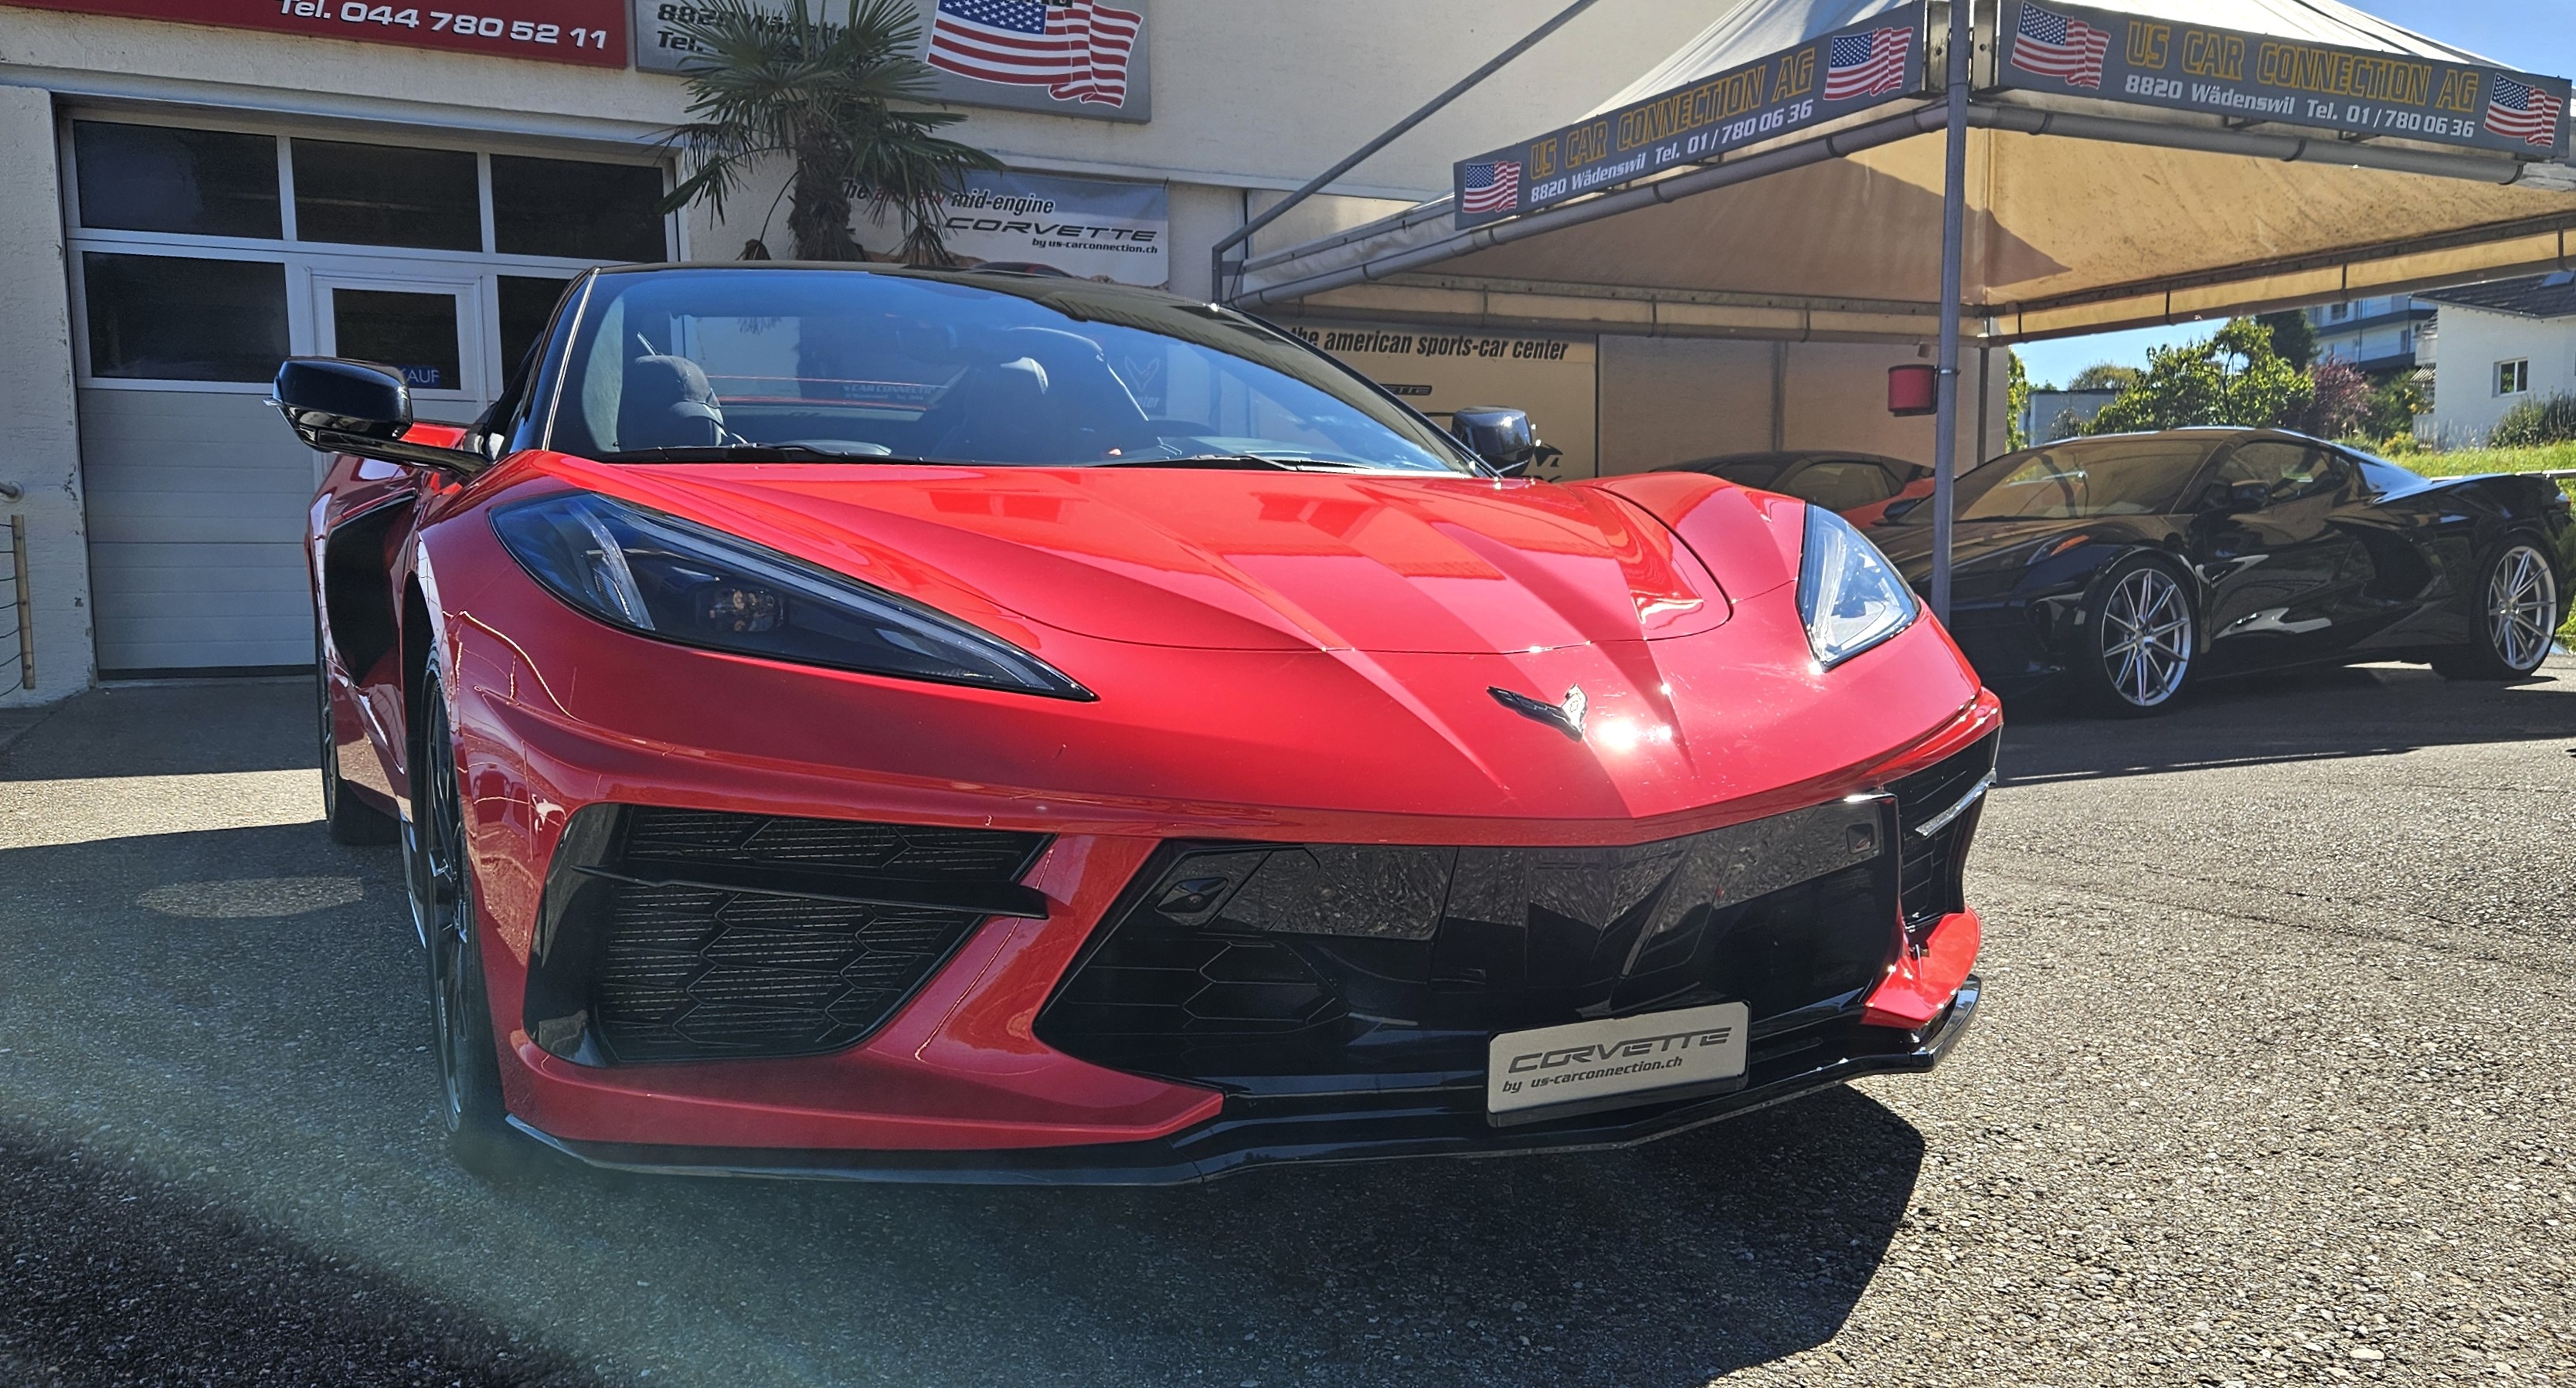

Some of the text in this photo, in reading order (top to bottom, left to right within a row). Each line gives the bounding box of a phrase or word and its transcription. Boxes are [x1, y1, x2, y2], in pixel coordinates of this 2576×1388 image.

[280, 0, 607, 49] Tel. 044 780 52 11
[2126, 20, 2479, 113] US CAR CONNECTION AG
[1530, 47, 1816, 181] US CAR CONNECTION AG
[2125, 74, 2183, 100] 8820
[2191, 83, 2295, 116] Wädenswil
[2307, 99, 2338, 121] Tel.
[2423, 114, 2448, 134] 06
[2449, 118, 2476, 139] 36
[1531, 177, 1566, 203] 8820
[1571, 152, 1647, 192] Wädenswil
[1655, 144, 1681, 165] Tel.
[1759, 107, 1785, 131] 06
[1787, 100, 1814, 124] 36
[950, 188, 1055, 215] mid-engine
[945, 217, 1157, 243] CORVETTE
[1031, 238, 1158, 254] by us-carconnection.ch
[1324, 331, 1412, 354] american
[1416, 334, 1511, 358] sports-car
[1512, 338, 1570, 361] center
[402, 368, 440, 383] AUF
[1507, 1027, 1732, 1074] CORVETTE
[1502, 1056, 1683, 1094] by us-carconnection.ch
